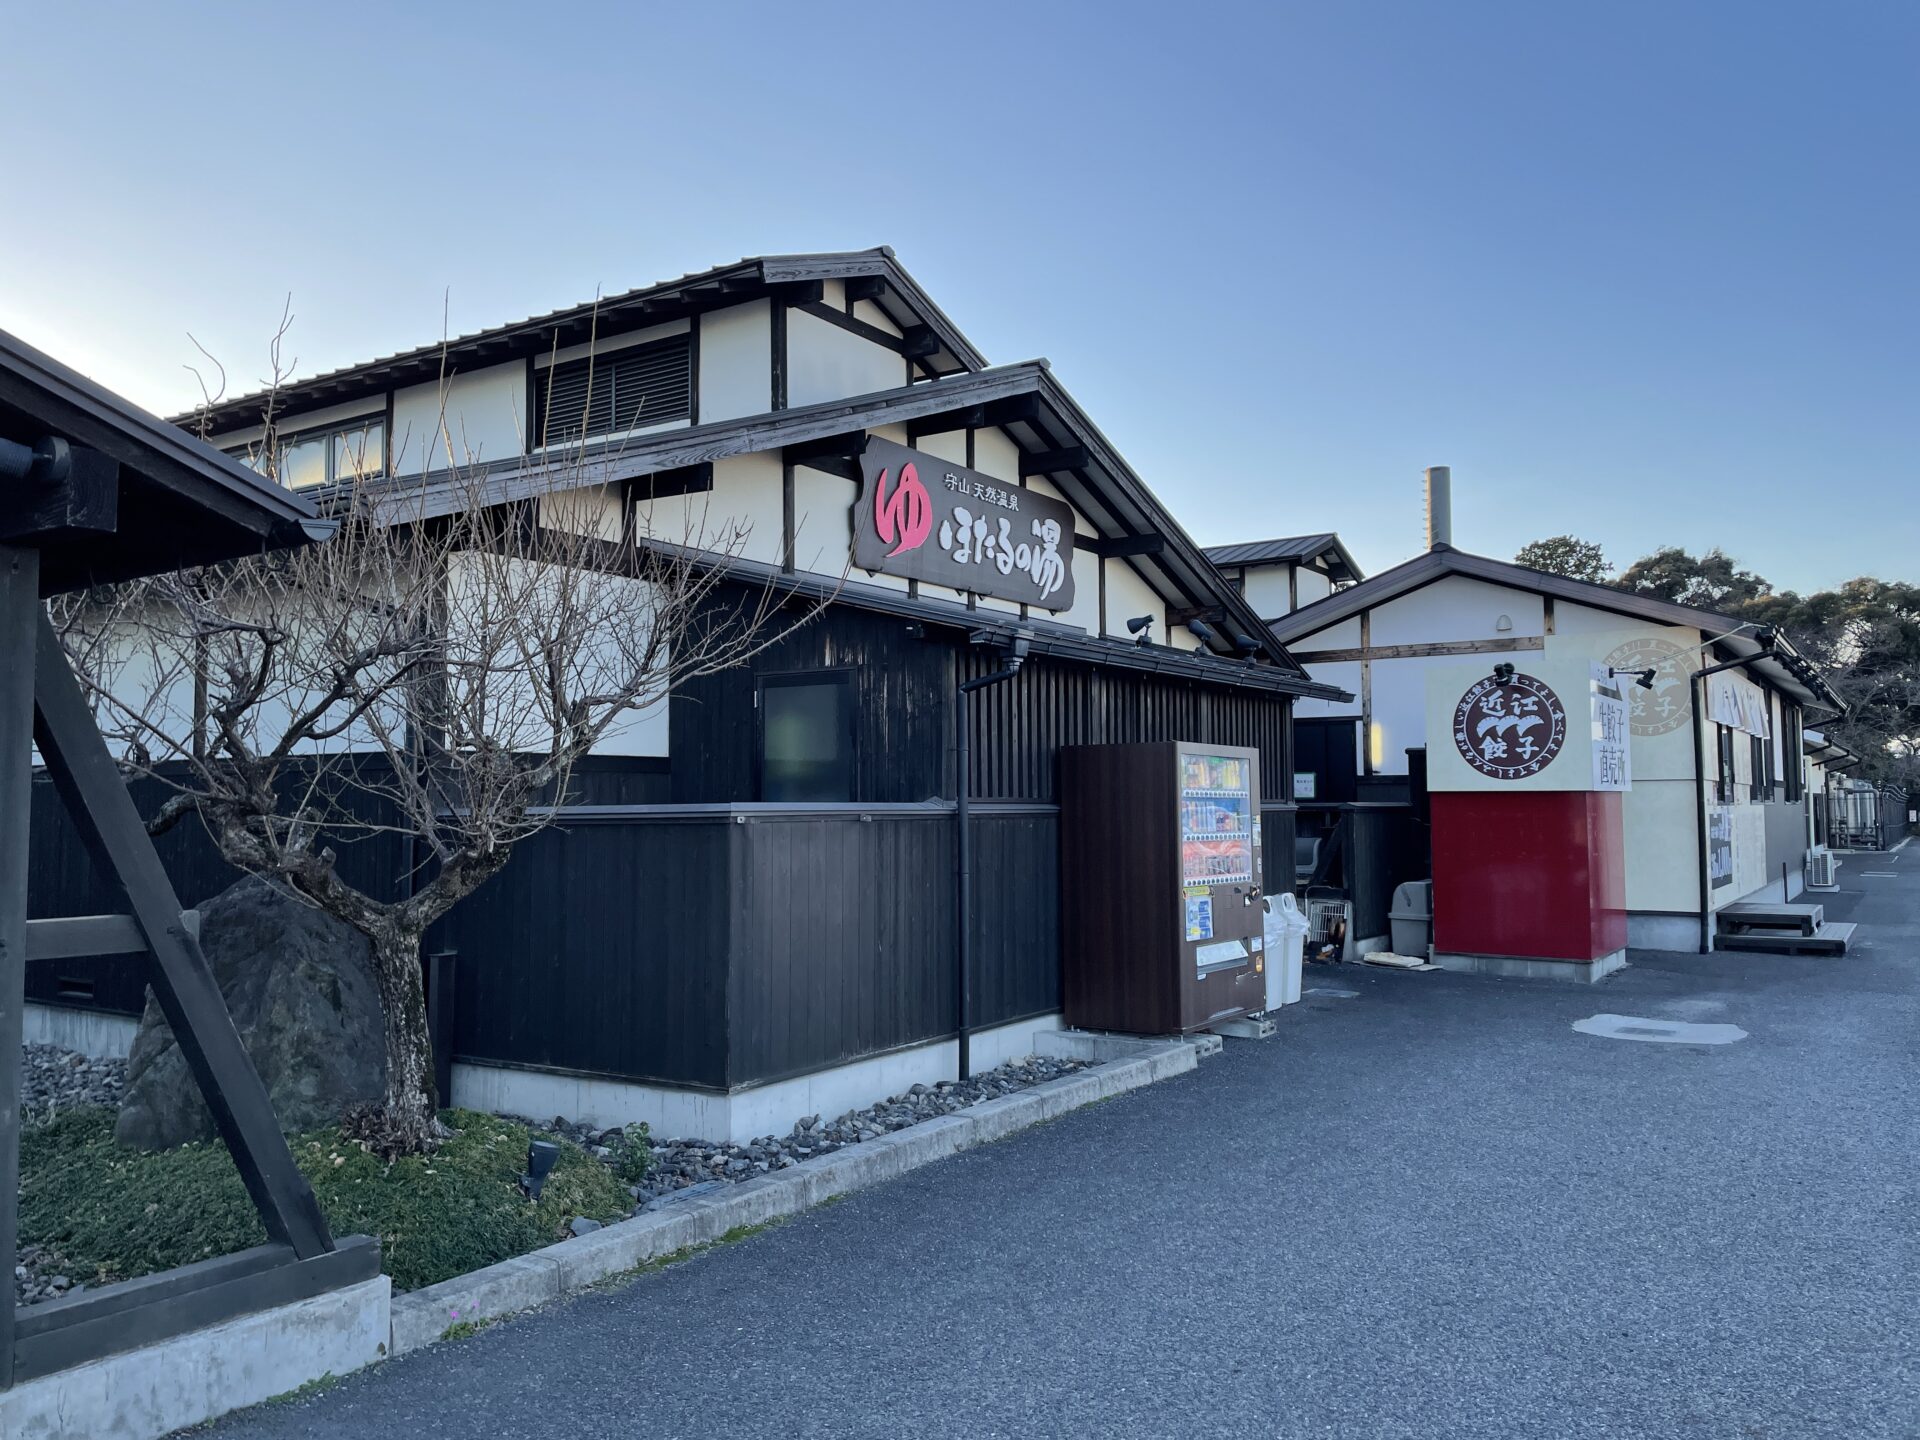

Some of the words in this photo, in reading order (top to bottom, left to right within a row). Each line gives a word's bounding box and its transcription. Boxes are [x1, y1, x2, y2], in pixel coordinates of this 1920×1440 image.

[875, 462, 933, 558] ゆ
[944, 472, 971, 495] 守山
[973, 482, 1020, 512] 天然温泉
[938, 506, 1065, 601] ほたるの湯
[1478, 689, 1539, 717] 近江
[1478, 735, 1540, 761] 餃子
[1599, 746, 1626, 786] 直売所
